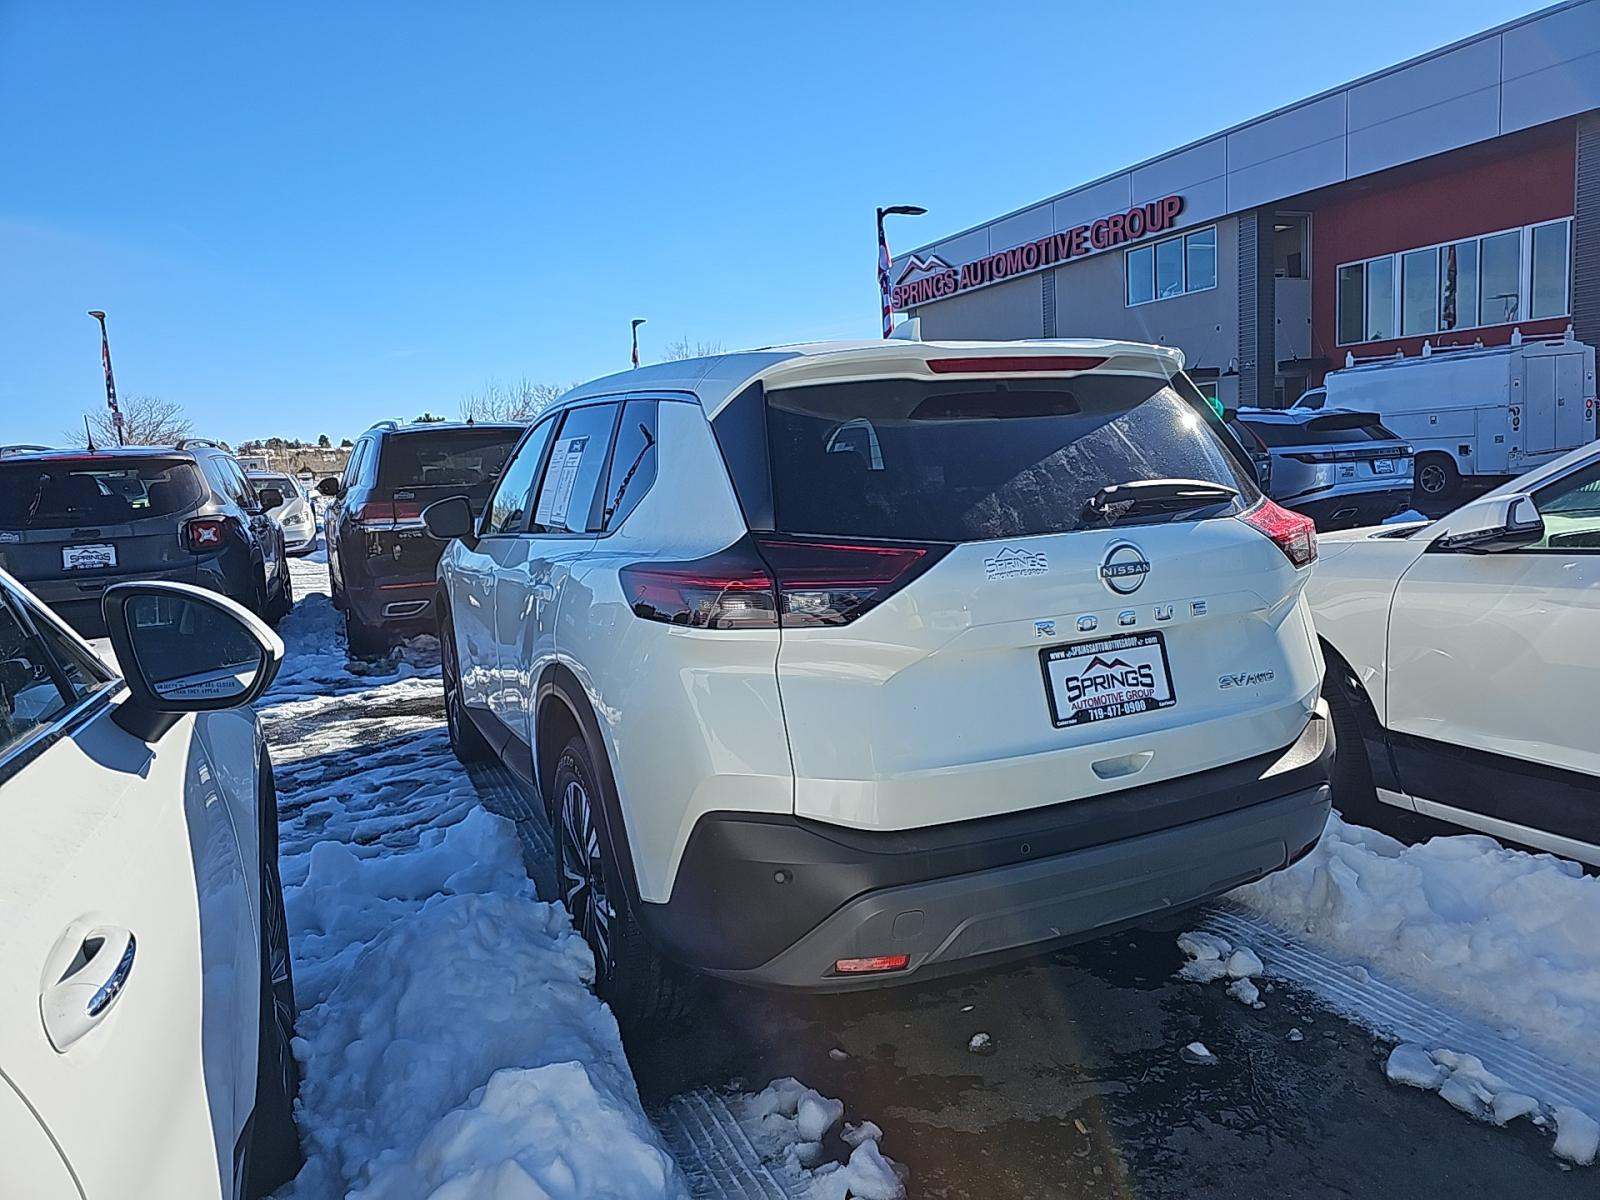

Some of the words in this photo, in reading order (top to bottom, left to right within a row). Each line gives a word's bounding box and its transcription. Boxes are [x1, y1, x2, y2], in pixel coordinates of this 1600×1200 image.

[892, 268, 956, 308] SPRINGS
[959, 226, 1089, 289] AUTOMOTIVE
[1090, 195, 1183, 249] GROUP
[1102, 563, 1150, 577] NISSAN
[1034, 600, 1207, 638] ROGUE
[1065, 664, 1155, 703] SPRINGS
[1071, 691, 1124, 711] AUTOMOTIVE
[1125, 688, 1155, 701] GROUP
